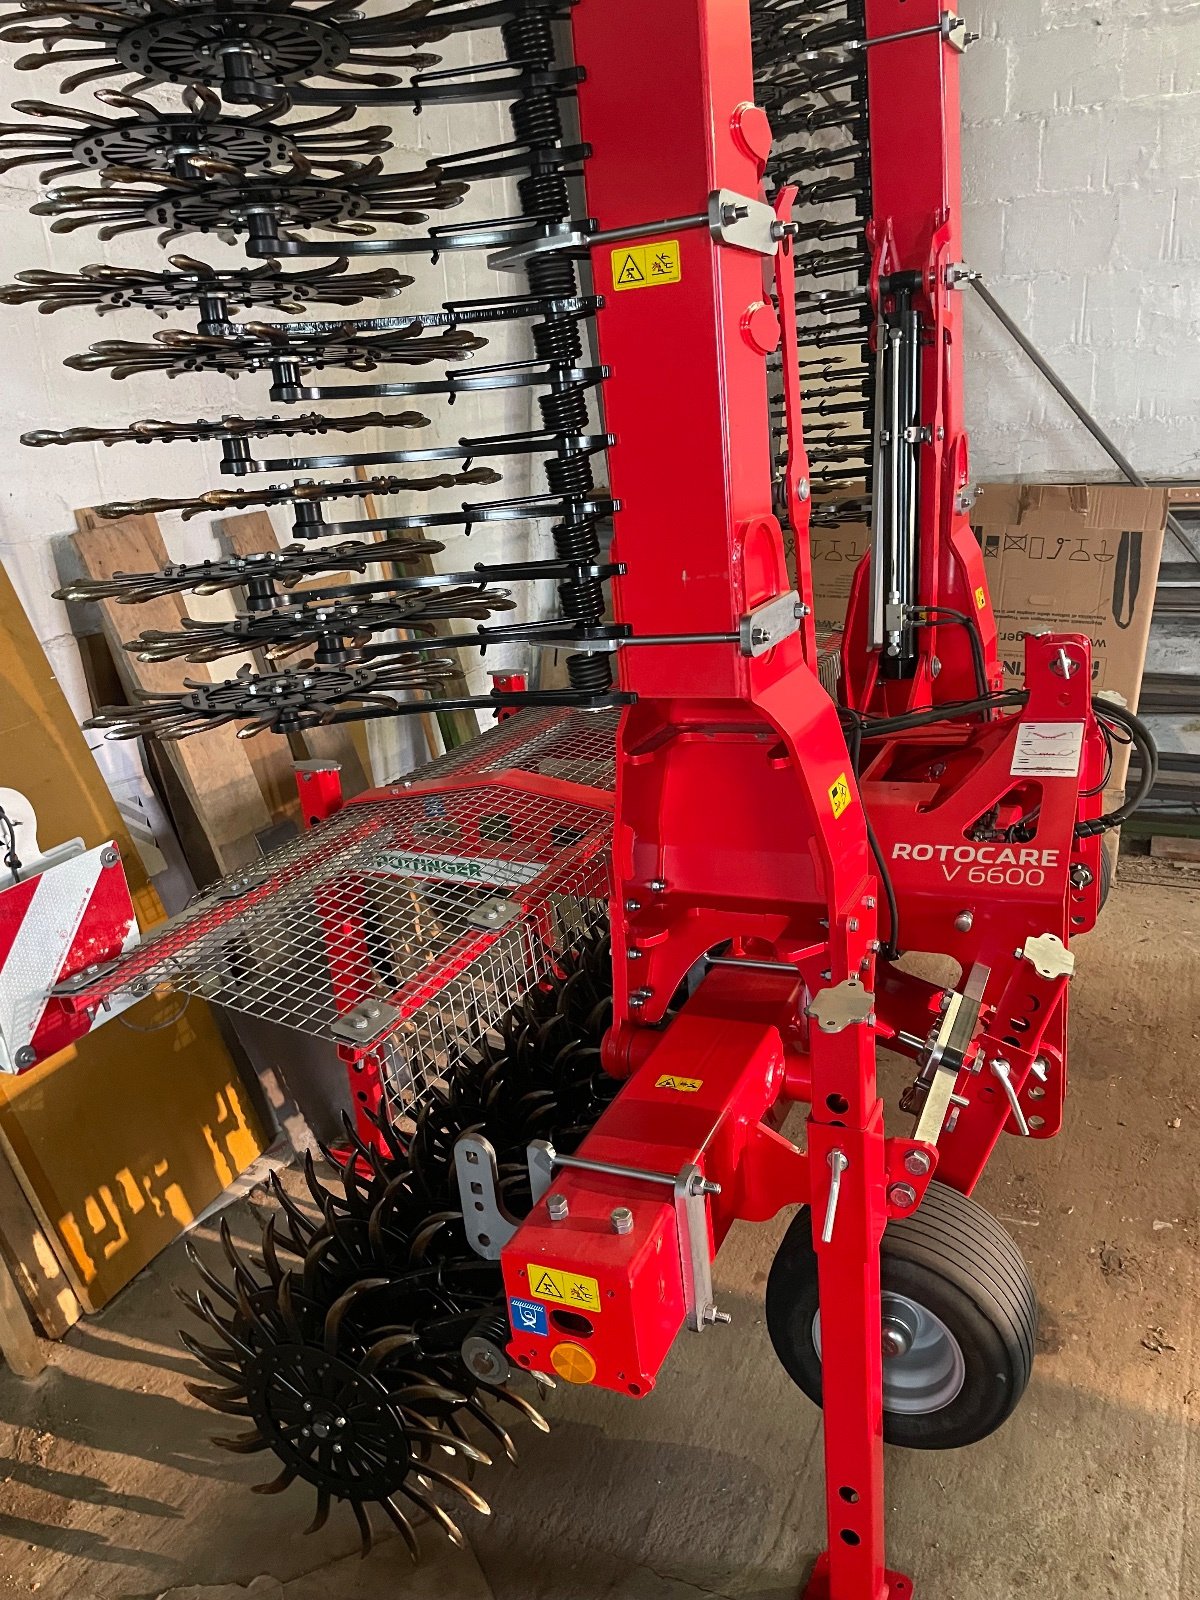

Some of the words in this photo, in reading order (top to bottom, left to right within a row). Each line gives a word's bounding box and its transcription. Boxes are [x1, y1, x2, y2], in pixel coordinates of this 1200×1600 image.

[892, 844, 1060, 867] ROTOCARE
[942, 865, 962, 881] V
[968, 866, 1045, 886] 6600
